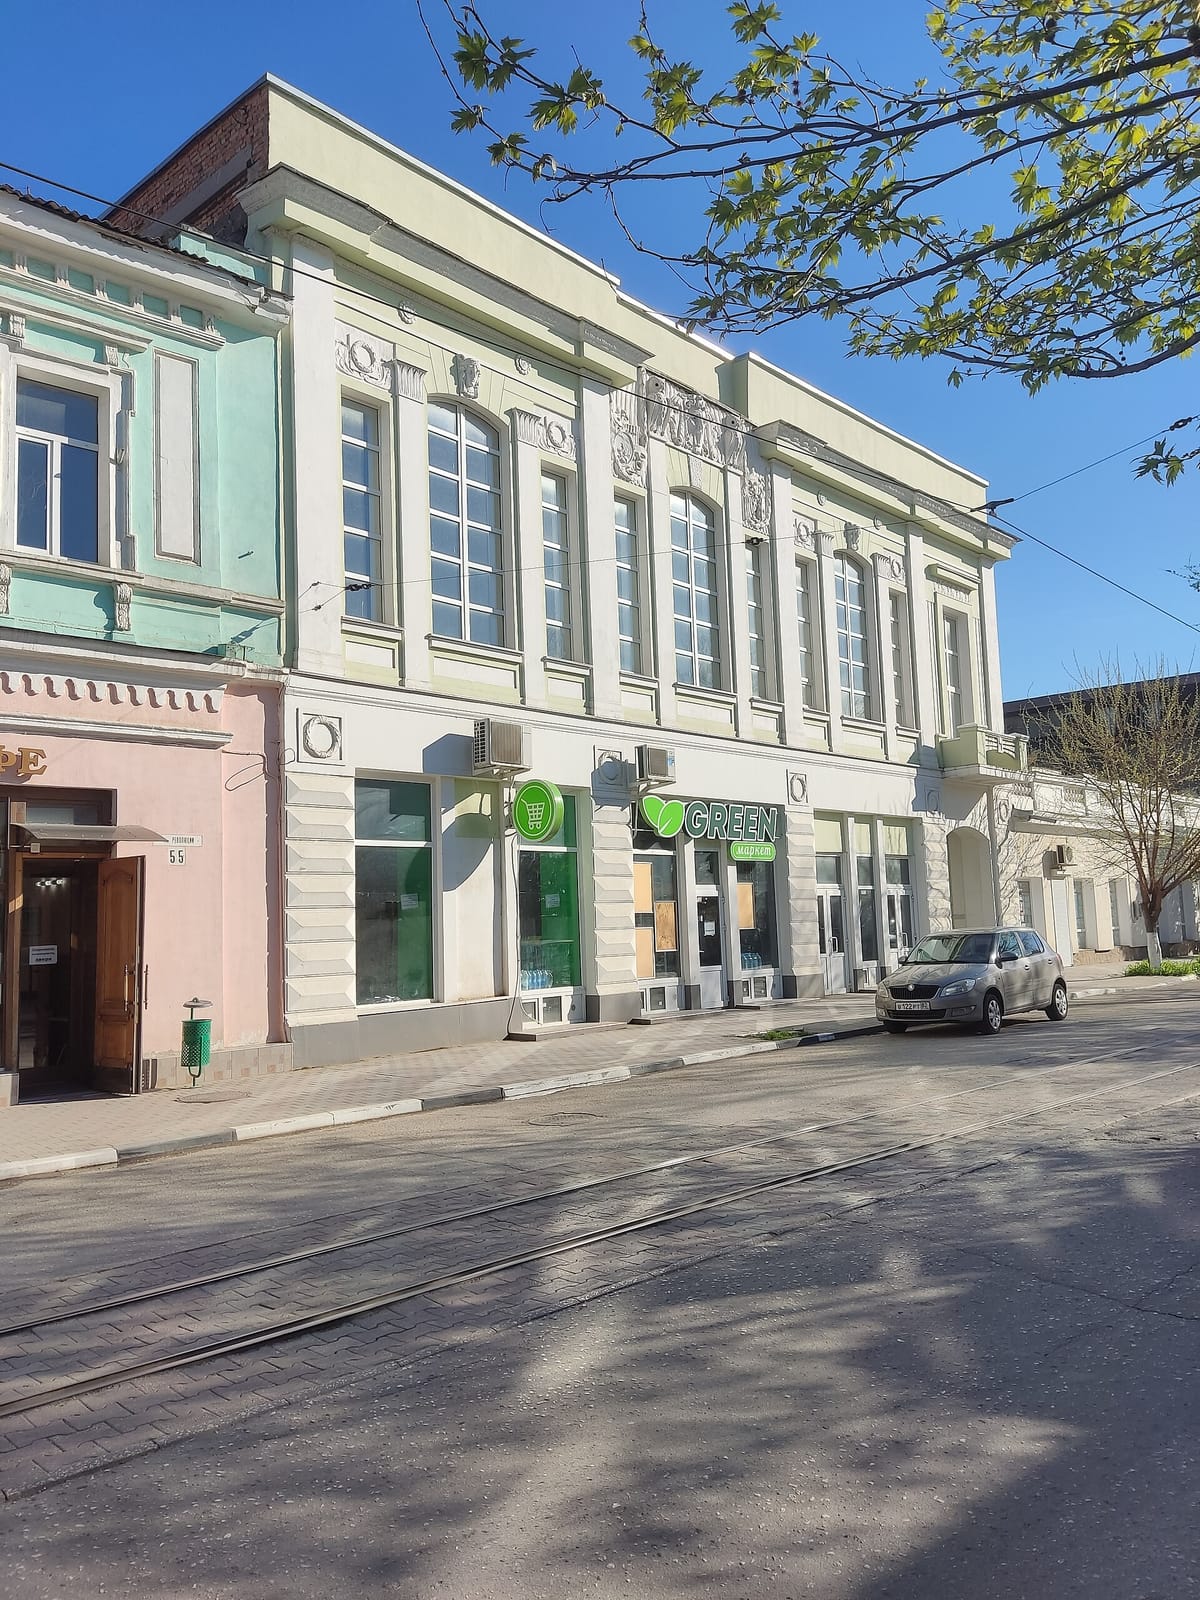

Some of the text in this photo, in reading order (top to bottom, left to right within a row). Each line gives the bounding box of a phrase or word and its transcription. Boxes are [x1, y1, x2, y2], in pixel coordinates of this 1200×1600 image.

[685, 801, 777, 842] GREEN
[170, 850, 184, 863] 55
[736, 845, 771, 858] маркет
